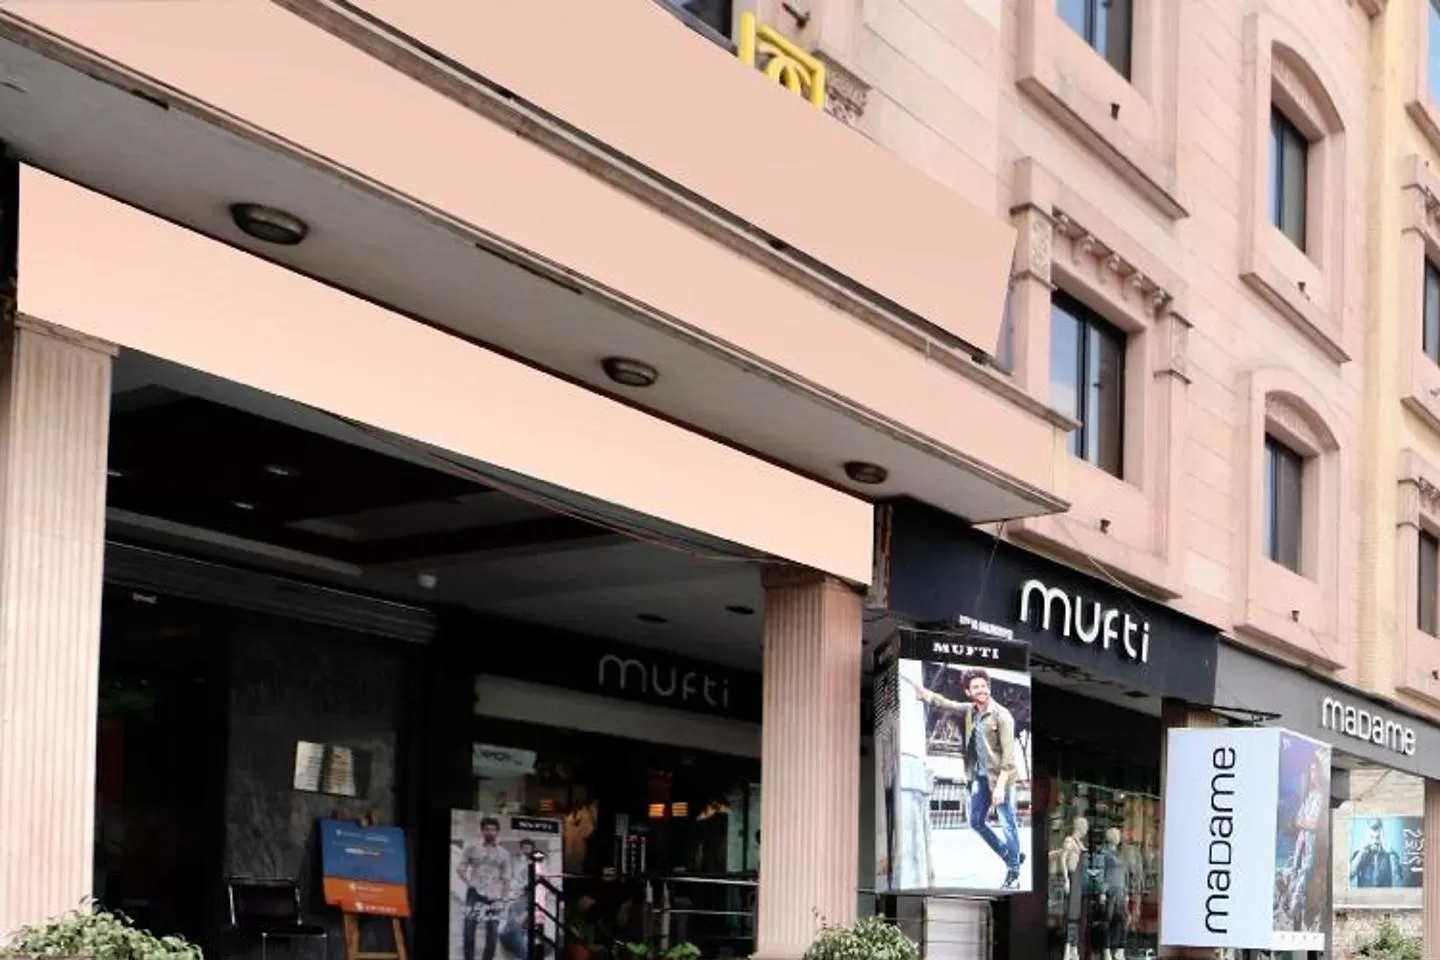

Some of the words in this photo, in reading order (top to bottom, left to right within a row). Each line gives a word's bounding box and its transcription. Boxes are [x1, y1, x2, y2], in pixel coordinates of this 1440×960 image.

[1020, 579, 1150, 664] mufti
[932, 641, 1000, 660] MUFTI
[598, 653, 730, 709] mufti
